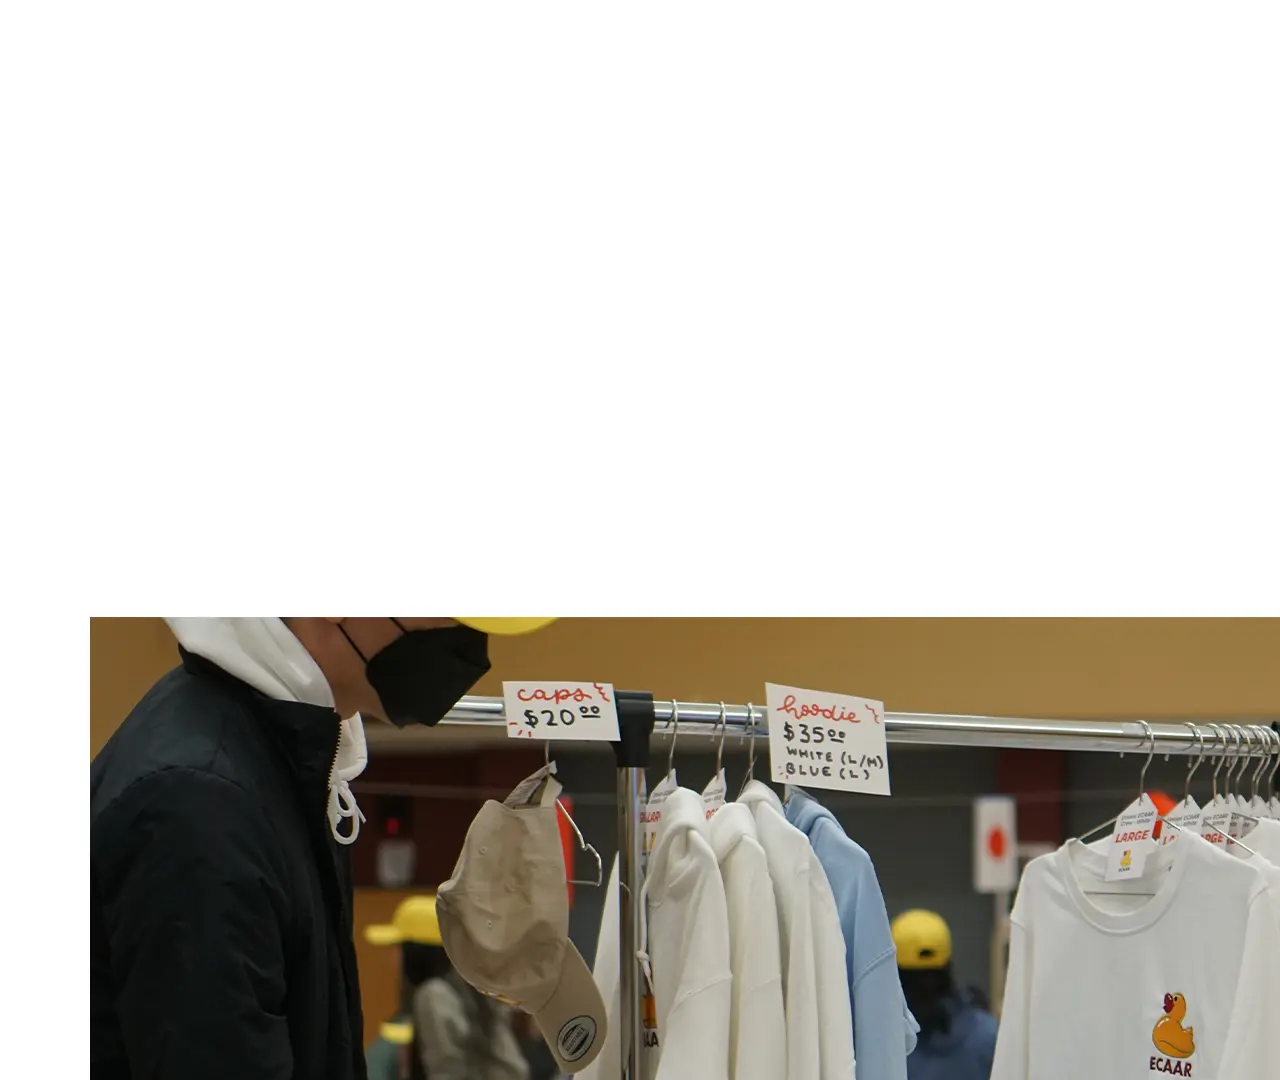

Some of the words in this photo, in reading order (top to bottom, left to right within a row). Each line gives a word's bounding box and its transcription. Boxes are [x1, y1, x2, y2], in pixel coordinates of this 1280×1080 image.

[517, 688, 592, 704] caps
[776, 695, 861, 723] hoodie
[786, 746, 833, 762] WHITE
[785, 762, 832, 776] BLUE
[1115, 829, 1150, 844] LARGE
[1149, 1056, 1192, 1078] ECAAR
